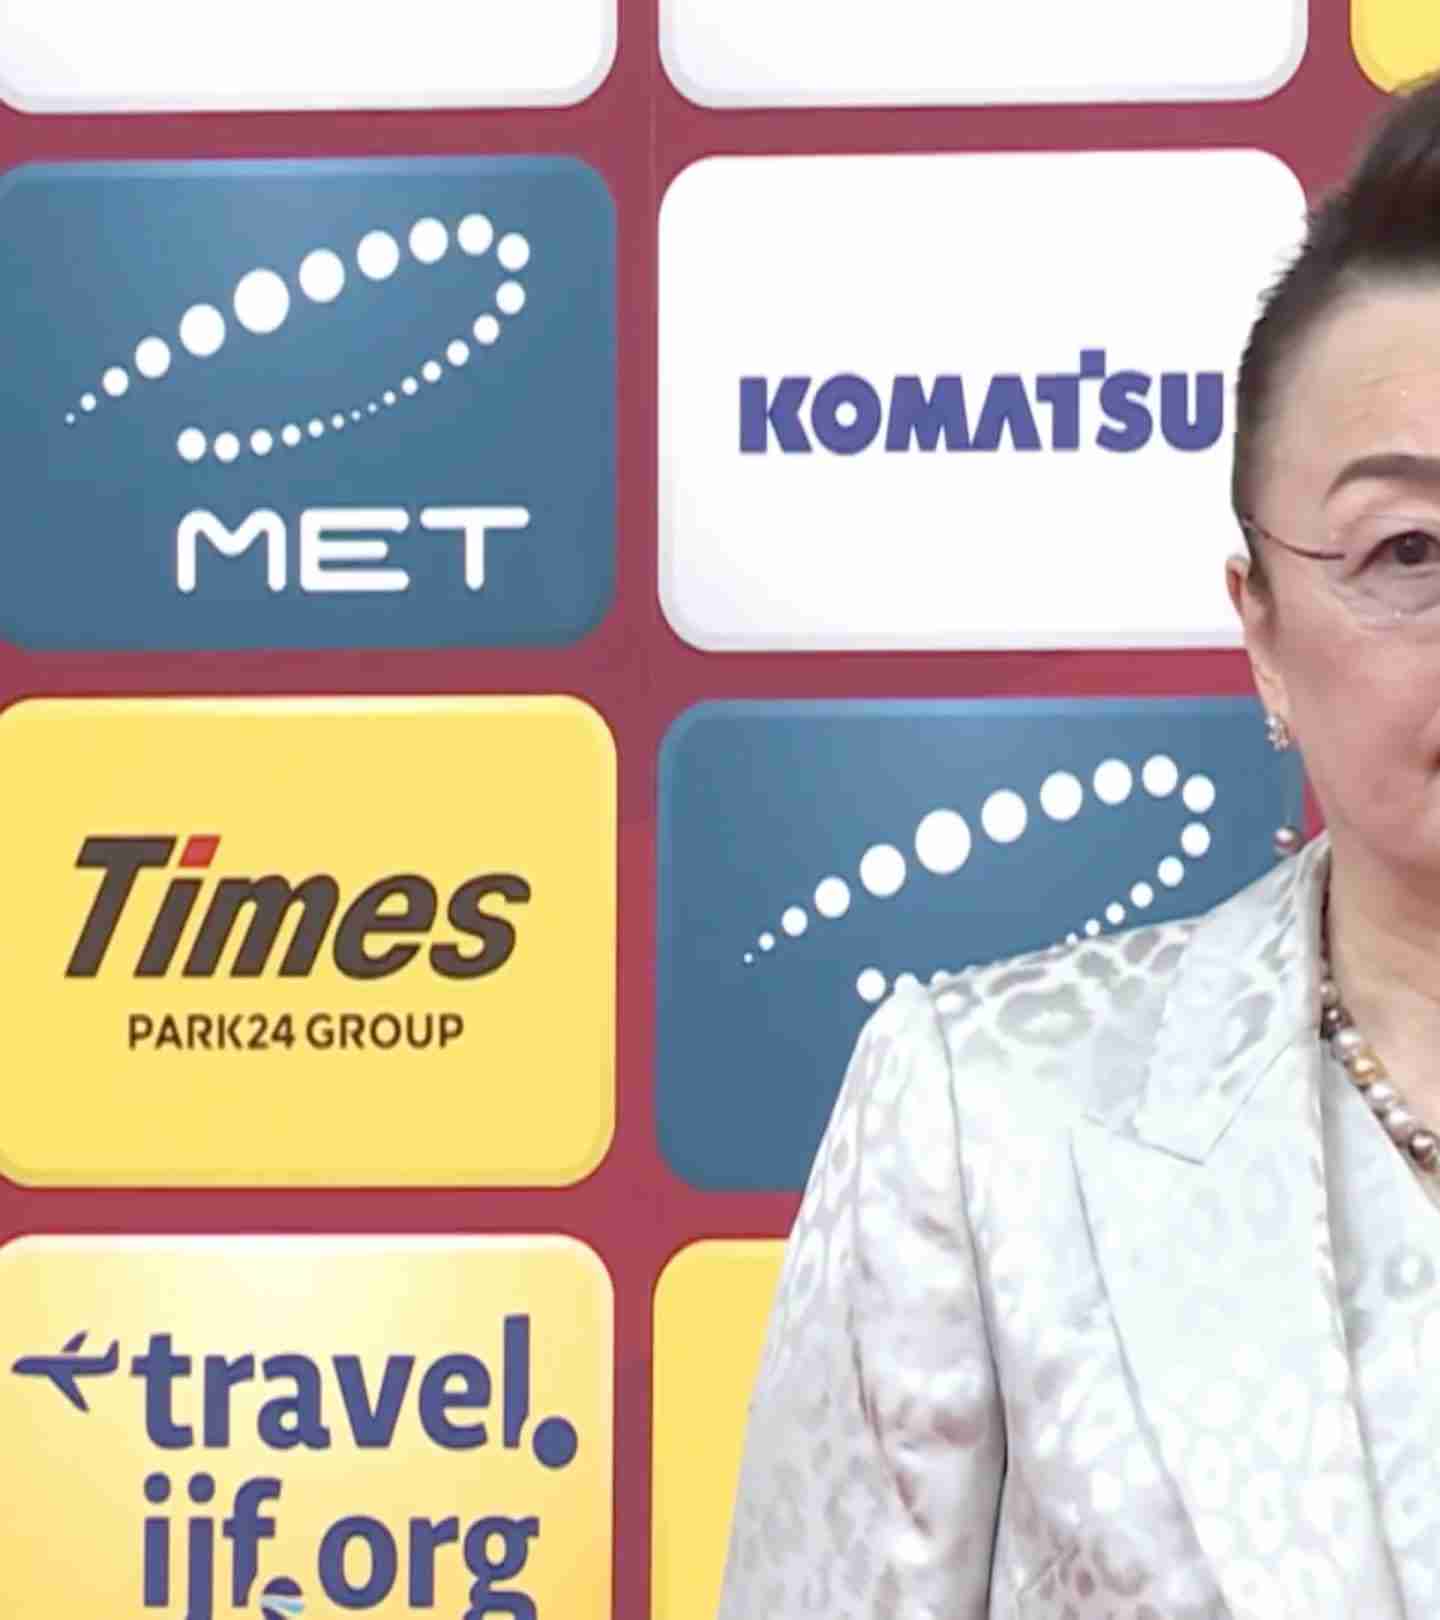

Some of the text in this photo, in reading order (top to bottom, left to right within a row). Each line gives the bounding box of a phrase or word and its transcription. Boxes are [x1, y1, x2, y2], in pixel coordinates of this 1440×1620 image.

[739, 349, 1224, 456] KOMATSU
[177, 507, 531, 593] MET
[65, 834, 532, 980] Times
[128, 1012, 465, 1051] PARK24 GROUP
